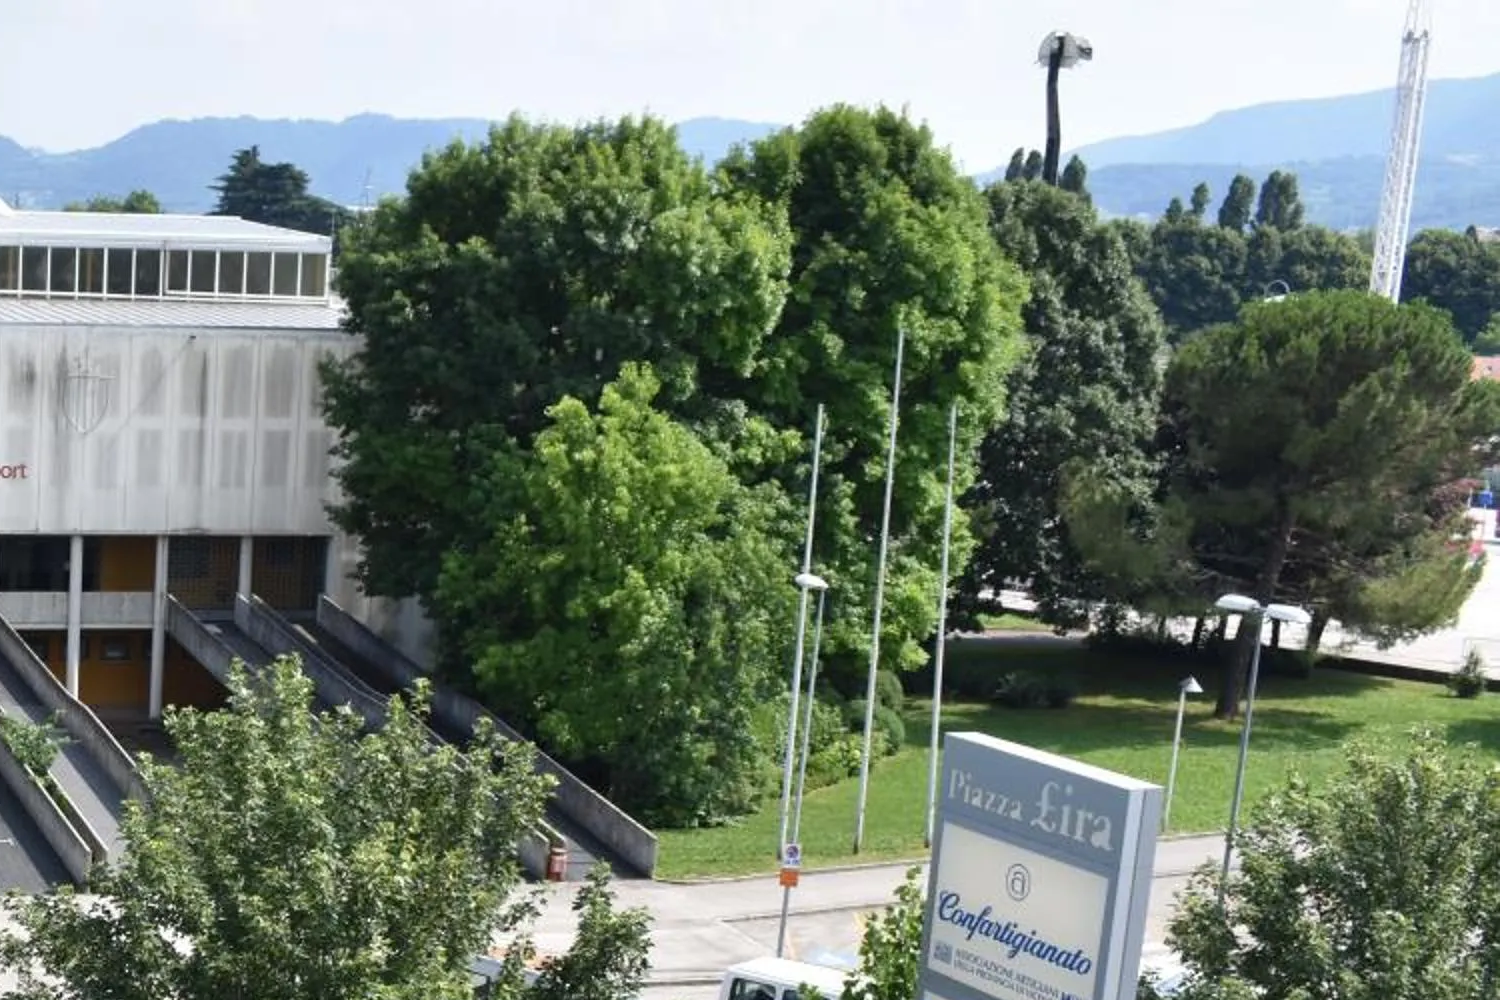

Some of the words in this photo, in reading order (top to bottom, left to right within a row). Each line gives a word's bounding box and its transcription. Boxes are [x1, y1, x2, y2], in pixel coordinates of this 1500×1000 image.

[947, 768, 1023, 820] Piazza
[938, 892, 1093, 976] Confartigianato
[955, 948, 1013, 979] ASSOCIAZIONE
